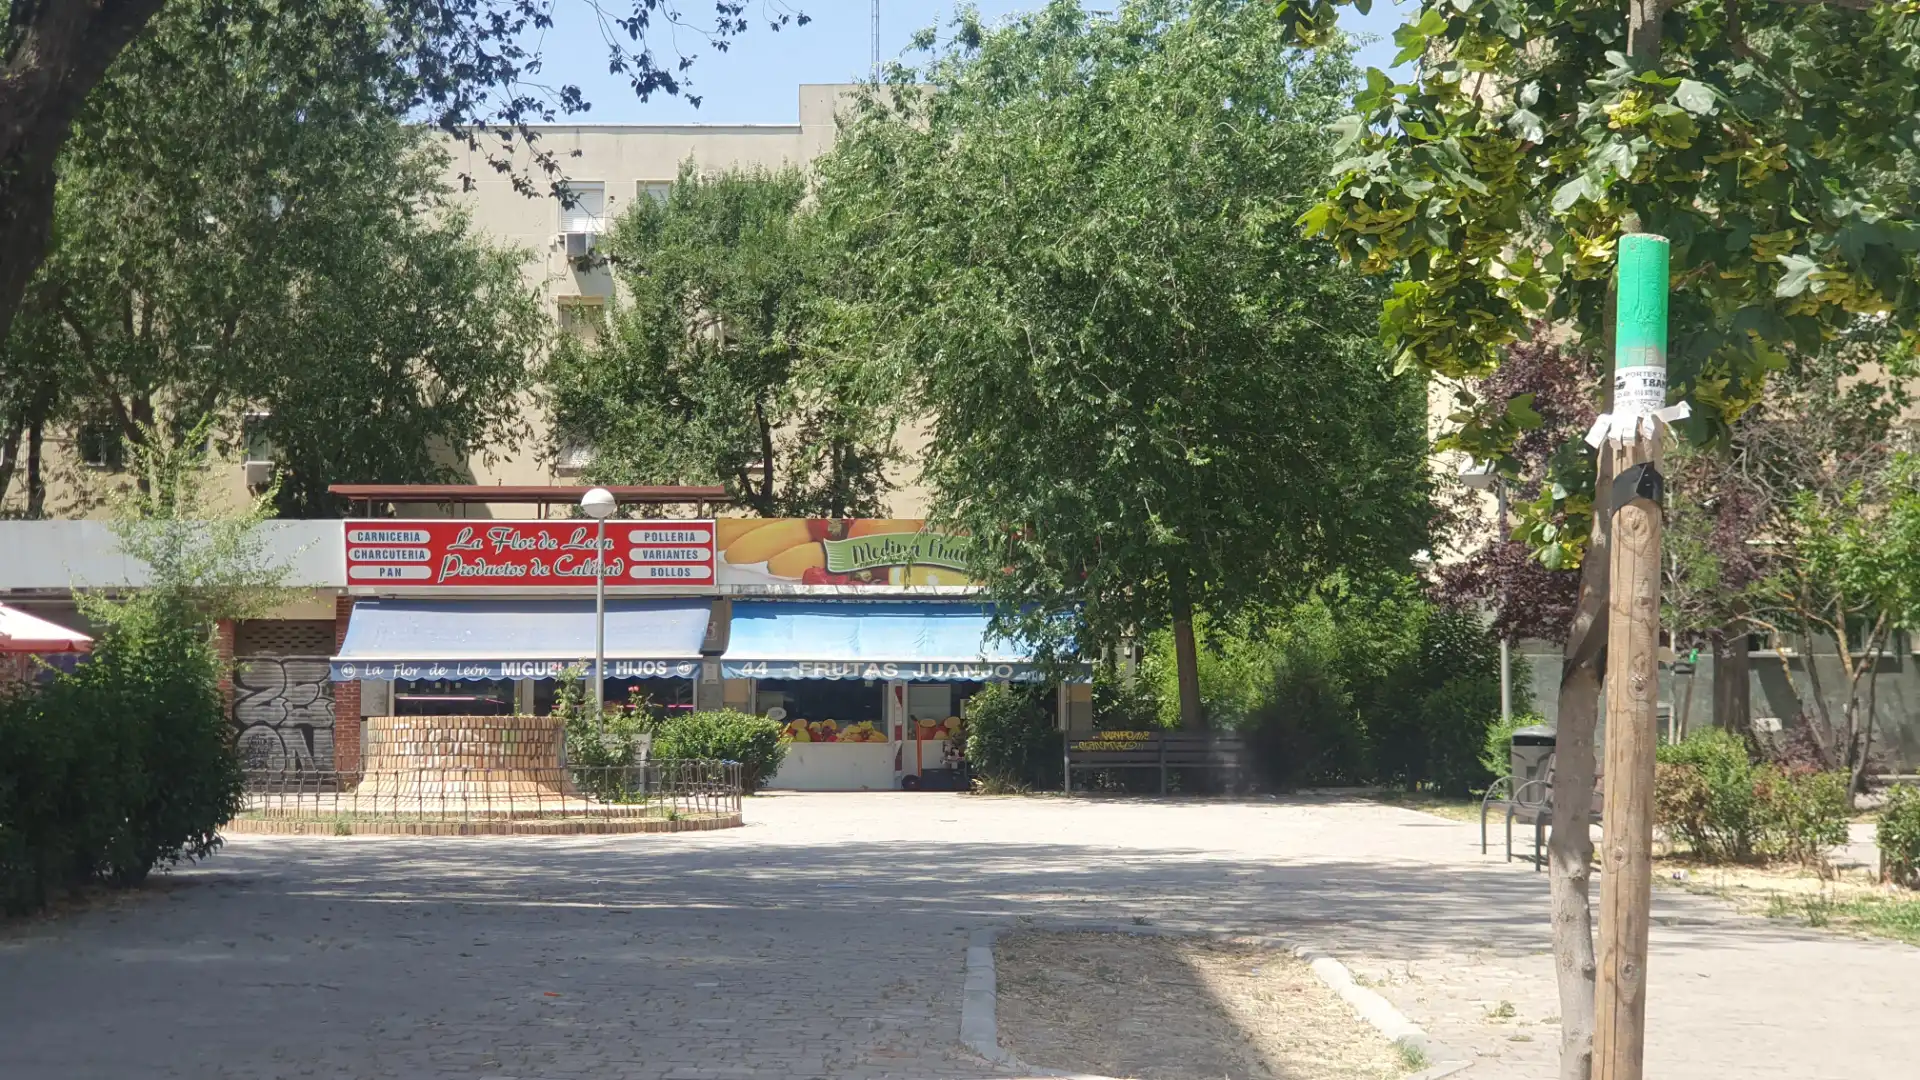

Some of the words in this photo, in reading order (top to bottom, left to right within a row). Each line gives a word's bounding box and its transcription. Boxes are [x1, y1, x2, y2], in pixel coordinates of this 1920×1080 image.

[357, 531, 421, 542] CARNICERIA
[447, 526, 483, 550] La
[487, 526, 536, 555] Flor
[538, 530, 559, 550] de
[644, 531, 696, 542] POLLERIA
[354, 549, 426, 560] CHARCUTERIA
[642, 549, 699, 560] VARIANTES
[851, 538, 920, 565] Medina
[379, 567, 402, 577] PAN
[438, 553, 527, 584] Productos
[530, 557, 551, 577] de
[650, 567, 691, 577] BOLLOS
[365, 663, 385, 676] La
[393, 662, 421, 678] Flor
[429, 662, 449, 677] de
[456, 663, 492, 677] León
[500, 661, 591, 676] MIGUELZ
[615, 661, 668, 675] HIJOS
[740, 661, 769, 675] 44
[798, 661, 899, 677] FRUTAS
[912, 662, 1014, 679] JUANJO
